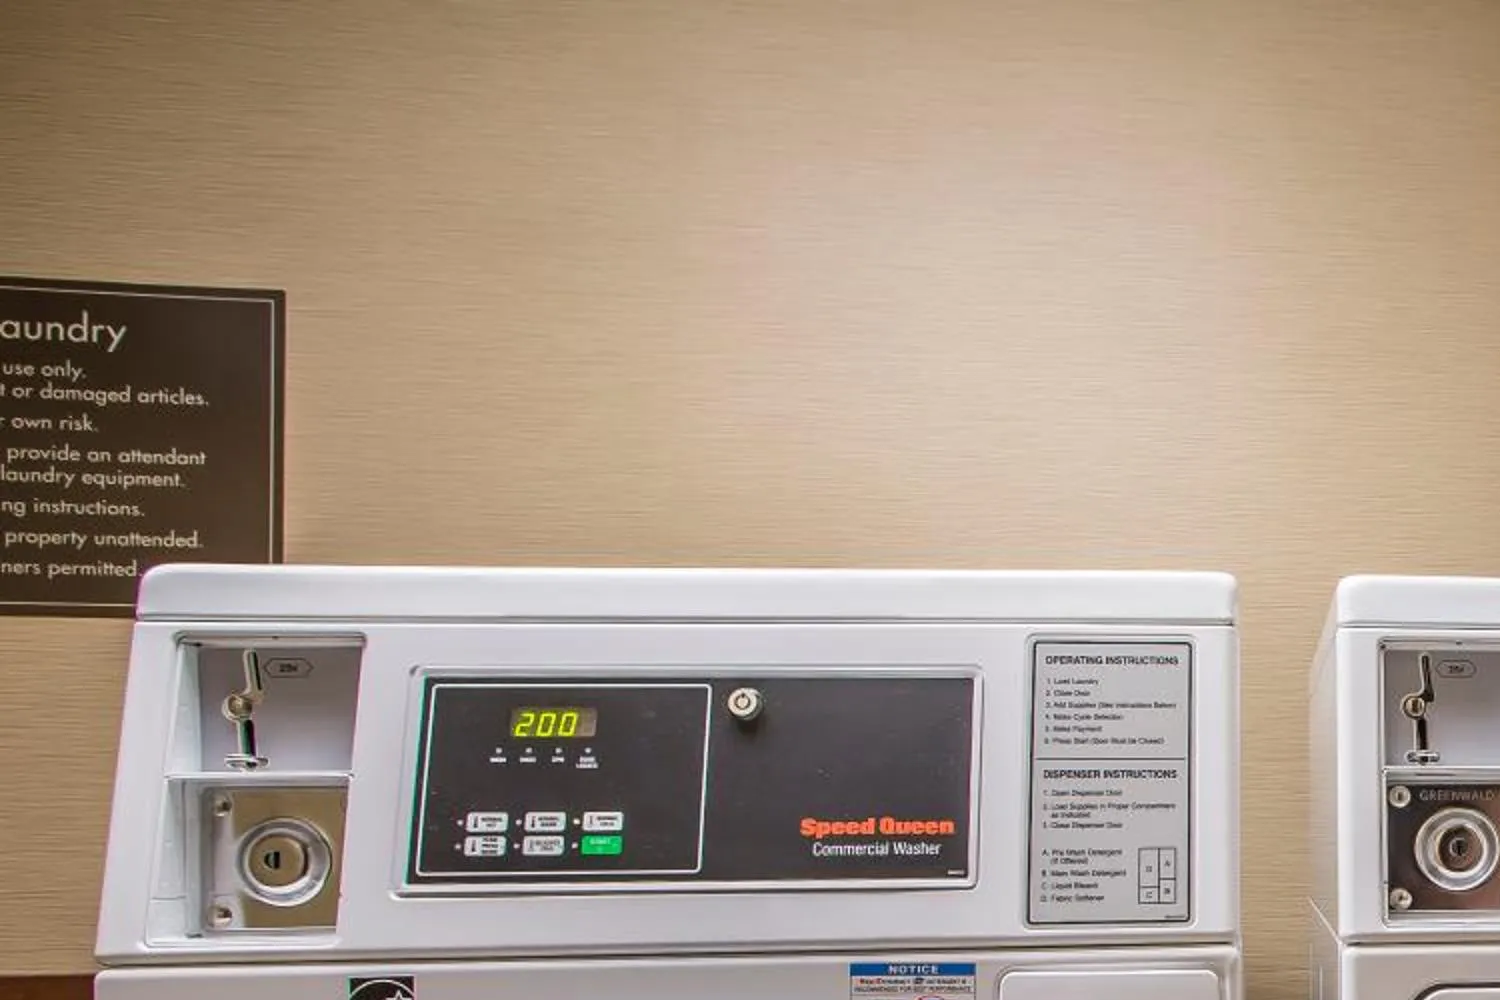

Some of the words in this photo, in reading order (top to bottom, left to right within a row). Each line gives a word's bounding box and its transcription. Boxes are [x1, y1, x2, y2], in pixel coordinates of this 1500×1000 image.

[0, 309, 127, 352] aundry
[3, 363, 35, 376] use
[41, 359, 87, 382] only.
[12, 385, 33, 399] or
[40, 382, 131, 407] damaged
[137, 386, 209, 405] articles.
[11, 416, 52, 429] own
[59, 412, 98, 432] risk.
[7, 443, 80, 463] provide
[87, 451, 111, 463] an
[118, 447, 206, 465] attendant
[0, 464, 75, 488] laundry
[81, 470, 186, 490] equipment.
[33, 498, 145, 516] instructions.
[5, 532, 87, 550] property
[94, 529, 203, 548] unattended.
[48, 560, 142, 579] permitted.
[1045, 655, 1103, 666] OPERATING
[1105, 655, 1179, 666] INSTRUCTIONS
[514, 711, 580, 737] 200
[1043, 769, 1100, 779] DISPENSER
[1103, 769, 1177, 779] INSTRUCTIONS
[800, 816, 876, 838] Speed
[879, 816, 955, 835] Queen
[813, 841, 889, 857] Commercial
[893, 841, 942, 856] Washer
[888, 964, 939, 975] NOTICE
